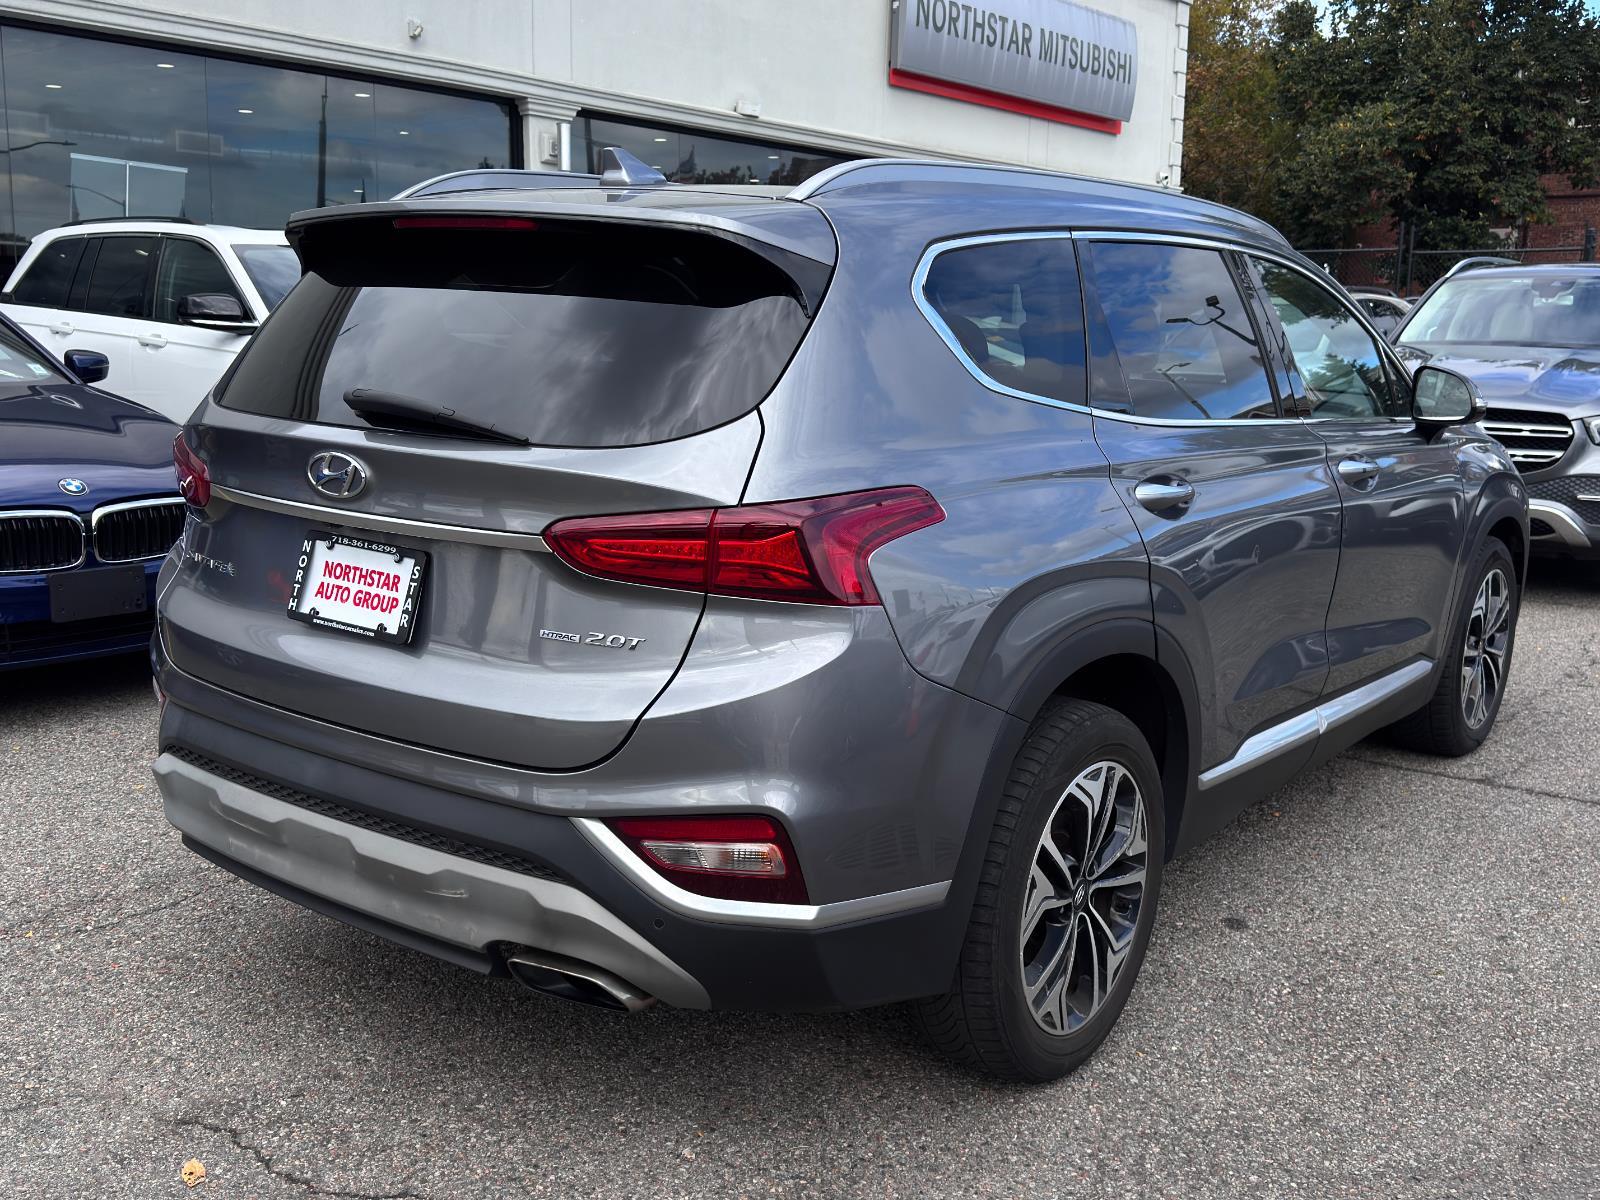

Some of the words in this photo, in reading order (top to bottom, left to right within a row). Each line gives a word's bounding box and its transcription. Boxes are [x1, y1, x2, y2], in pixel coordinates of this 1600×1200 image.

[915, 0, 1032, 58] NORTHSTAR
[1038, 28, 1132, 84] MITSUBISHI
[331, 535, 397, 554] 718-361-6299
[323, 560, 400, 593] NORTHSTAR
[314, 581, 351, 604] AUTO
[352, 589, 399, 614] GROUP
[540, 630, 579, 643] HTRAC
